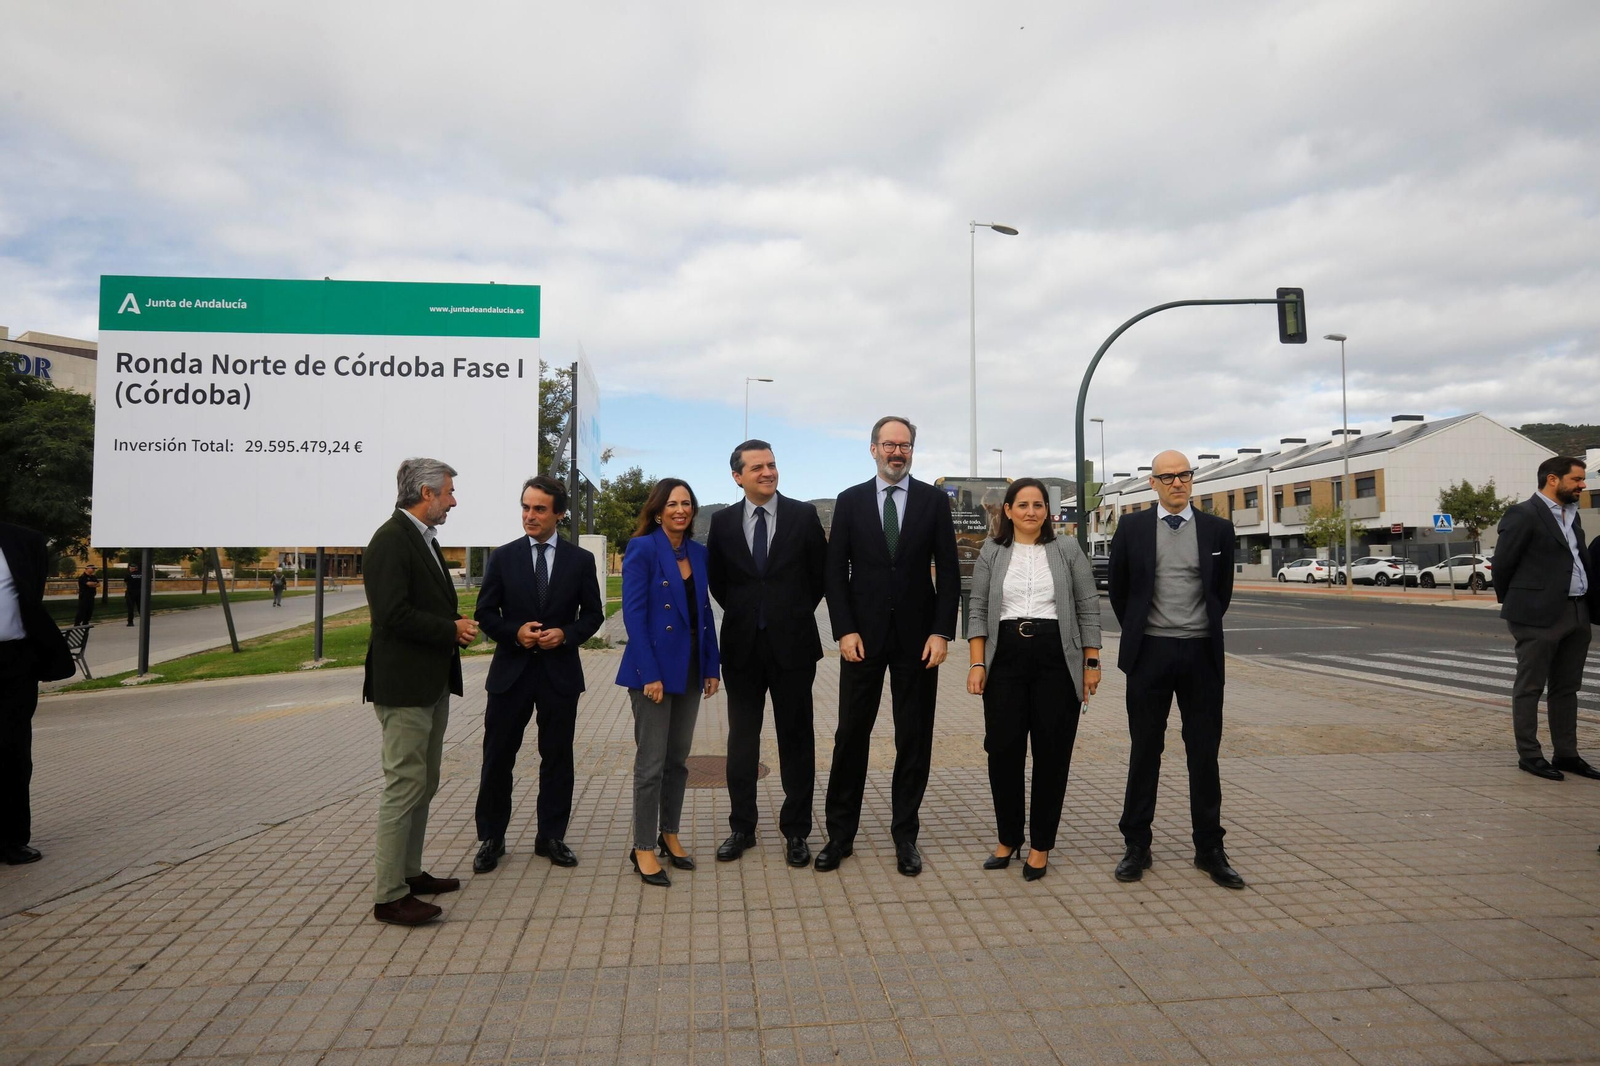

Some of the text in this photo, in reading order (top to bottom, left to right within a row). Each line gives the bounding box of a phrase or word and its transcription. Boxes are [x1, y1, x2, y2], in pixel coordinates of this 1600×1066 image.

[145, 298, 248, 309] Junta de Andalucía
[429, 305, 525, 314] www.juntadeandalucia.es
[116, 352, 524, 378] Ronda Norte de Córdoba Fase I
[115, 379, 251, 410] (Córdoba)
[114, 437, 363, 456] Inversión Total: 29.595.479,24 €
